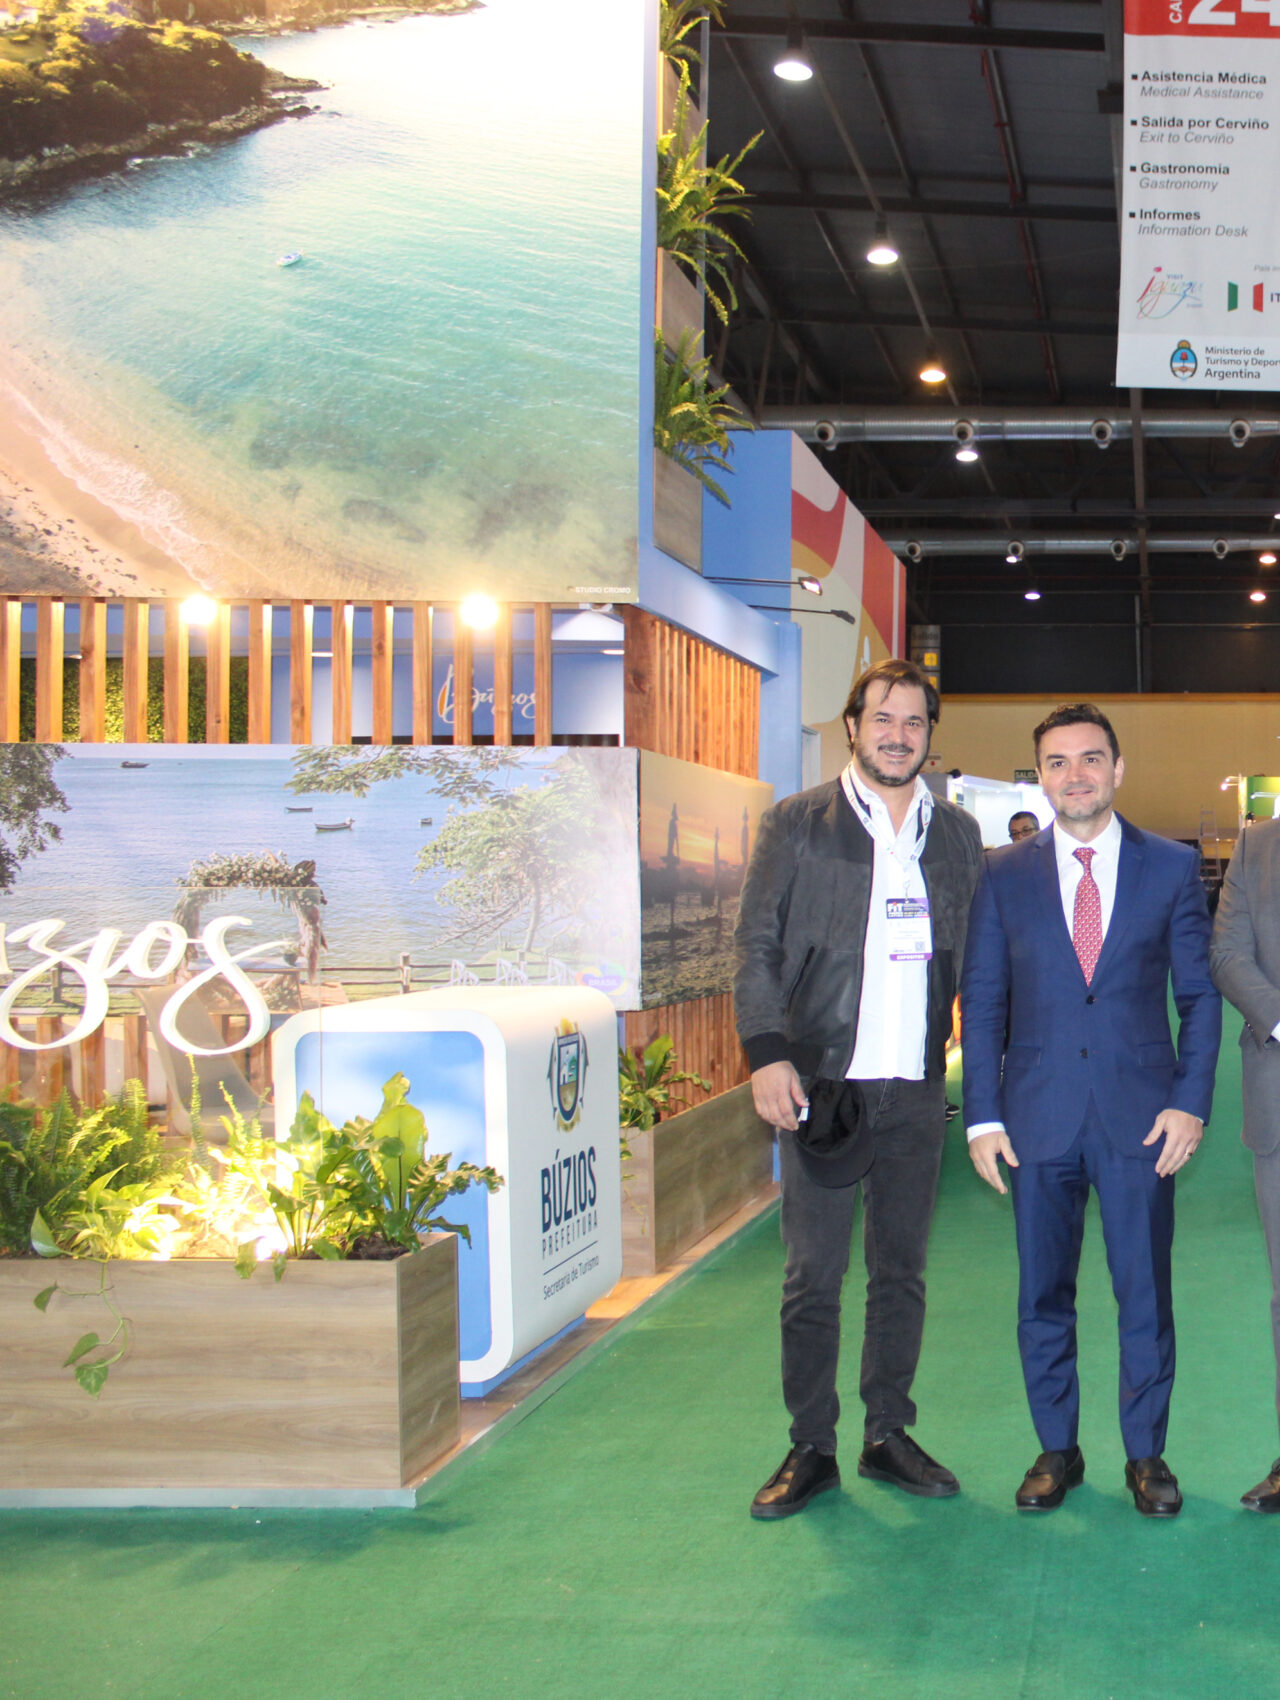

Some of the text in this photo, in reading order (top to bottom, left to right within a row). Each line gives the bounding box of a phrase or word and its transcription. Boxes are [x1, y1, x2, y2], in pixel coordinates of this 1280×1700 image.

[1169, 0, 1183, 23] CA
[1141, 71, 1267, 84] Asistencia Médica
[1140, 85, 1264, 100] Medical Assistance
[1141, 116, 1269, 130] Salida por Cerviño
[1140, 131, 1234, 144] Exit to Cerviño
[1139, 177, 1219, 192] Gastronomy
[1140, 209, 1201, 220] Informes
[1138, 223, 1248, 237] Information Desk
[1205, 346, 1265, 356] Ministerio de
[1205, 357, 1242, 366] Turismo
[1243, 359, 1249, 368] y
[1204, 369, 1261, 380] Argentina
[575, 586, 602, 594] STUDIO
[0, 915, 293, 1056] zios
[540, 1146, 597, 1234] BÚZIOS
[542, 1216, 599, 1261] PREFEITURA
[543, 1273, 571, 1300] Secretaria
[578, 1255, 600, 1276] Turismo
